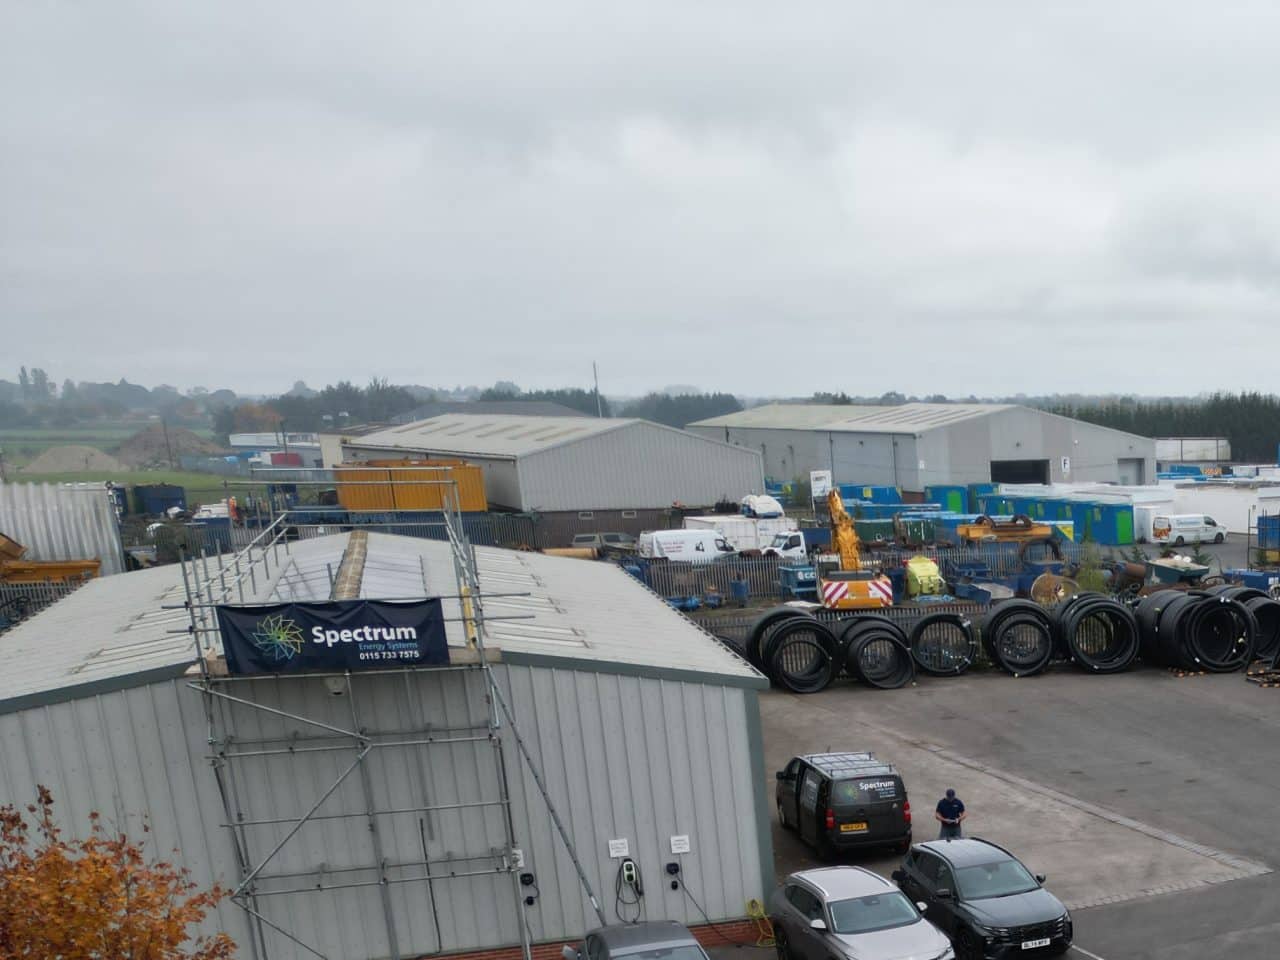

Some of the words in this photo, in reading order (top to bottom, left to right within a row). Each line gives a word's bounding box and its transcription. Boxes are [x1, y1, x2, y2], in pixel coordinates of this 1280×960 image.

[311, 625, 417, 647] Spectrum
[359, 643, 385, 651] Energy
[387, 642, 418, 650] Systems
[359, 652, 380, 660] 0115
[382, 651, 397, 659] 733
[399, 650, 420, 658] 7575
[859, 781, 895, 791] Spectrum
